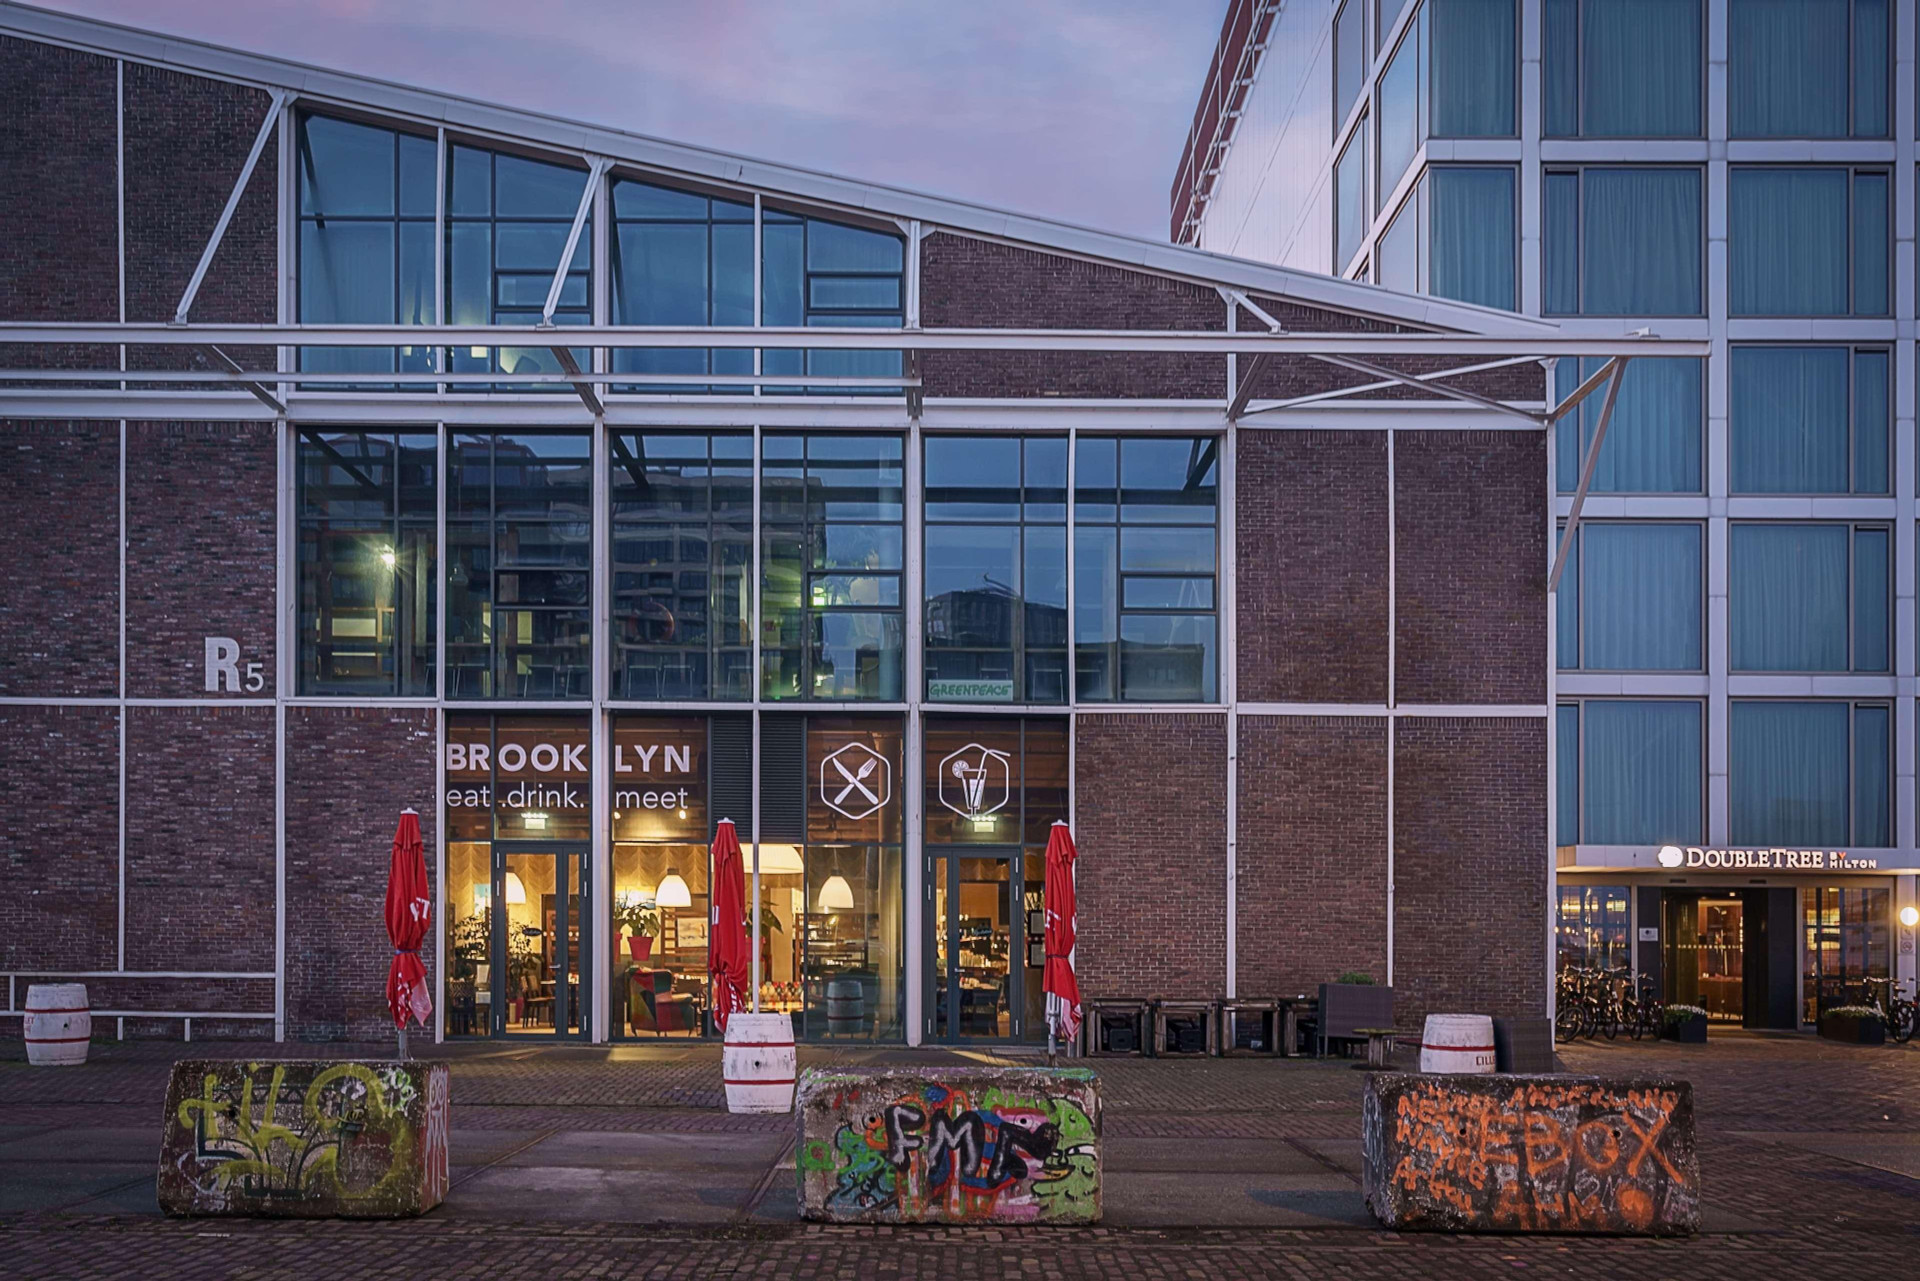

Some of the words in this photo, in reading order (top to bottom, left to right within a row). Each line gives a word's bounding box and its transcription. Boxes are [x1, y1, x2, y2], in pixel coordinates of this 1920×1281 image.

[930, 683, 1012, 697] GREENPEACE
[446, 786, 491, 808] eat
[615, 787, 688, 810] meet
[1829, 859, 1877, 869] HILTON
